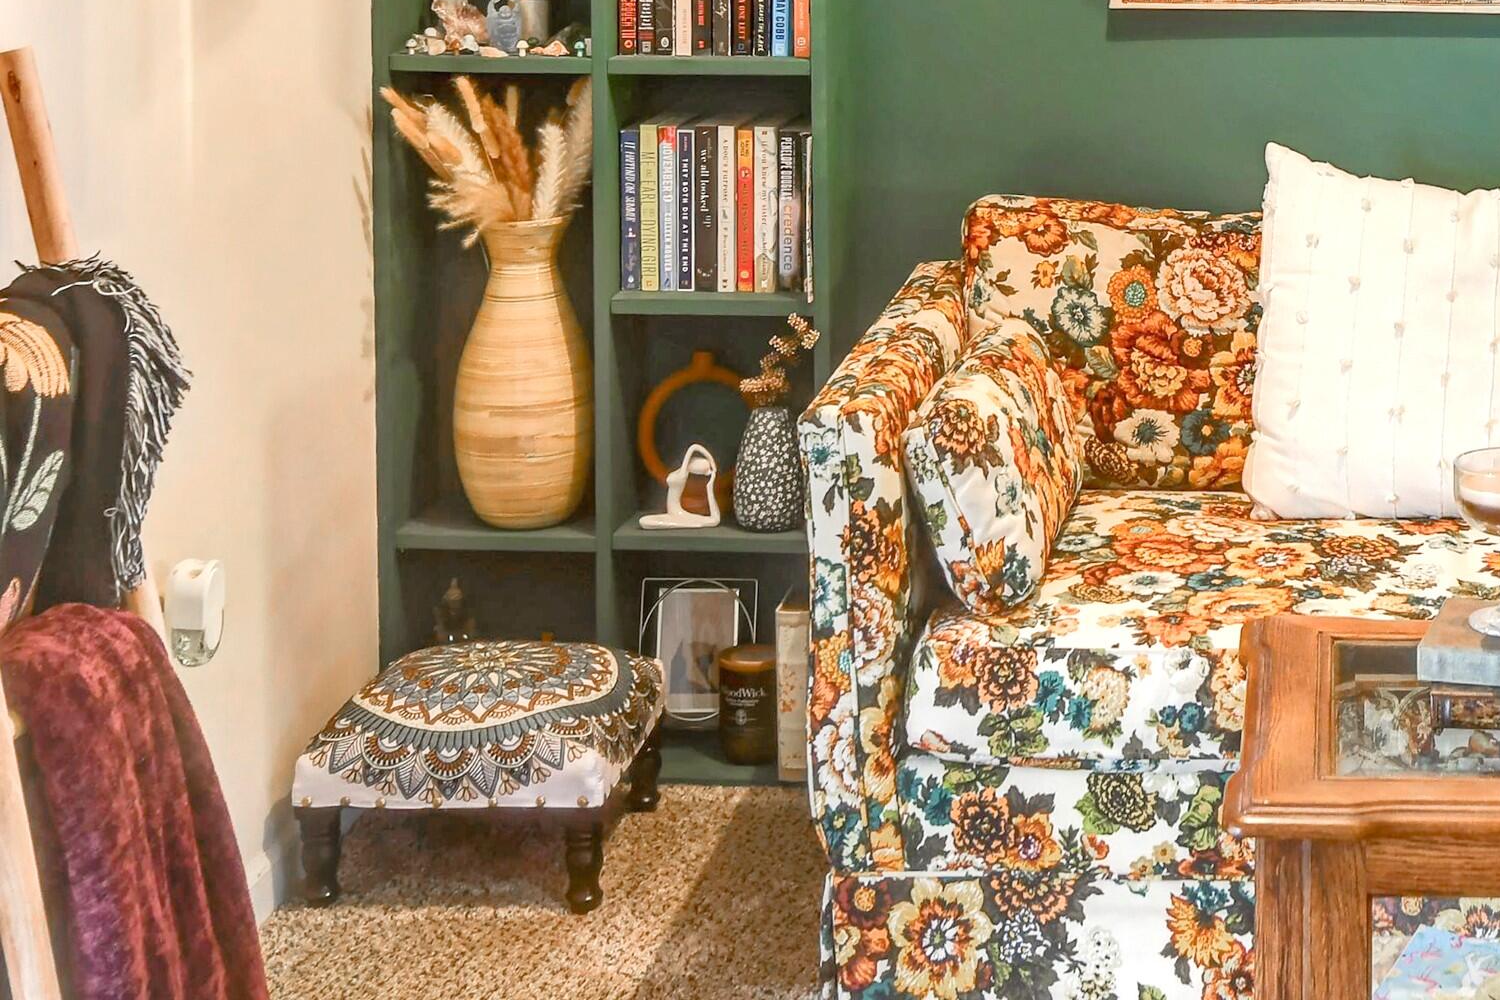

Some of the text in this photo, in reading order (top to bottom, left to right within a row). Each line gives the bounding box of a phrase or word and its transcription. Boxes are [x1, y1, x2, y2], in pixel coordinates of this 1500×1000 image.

[738, 5, 746, 21] ONE
[738, 21, 746, 40] LEFT
[776, 16, 785, 40] COBB
[700, 149, 710, 212] we all looked
[781, 137, 793, 201] PENELOPE DOUGLAS
[642, 219, 656, 277] DYING GIRL
[682, 224, 688, 234] AT
[783, 205, 794, 270] credence
